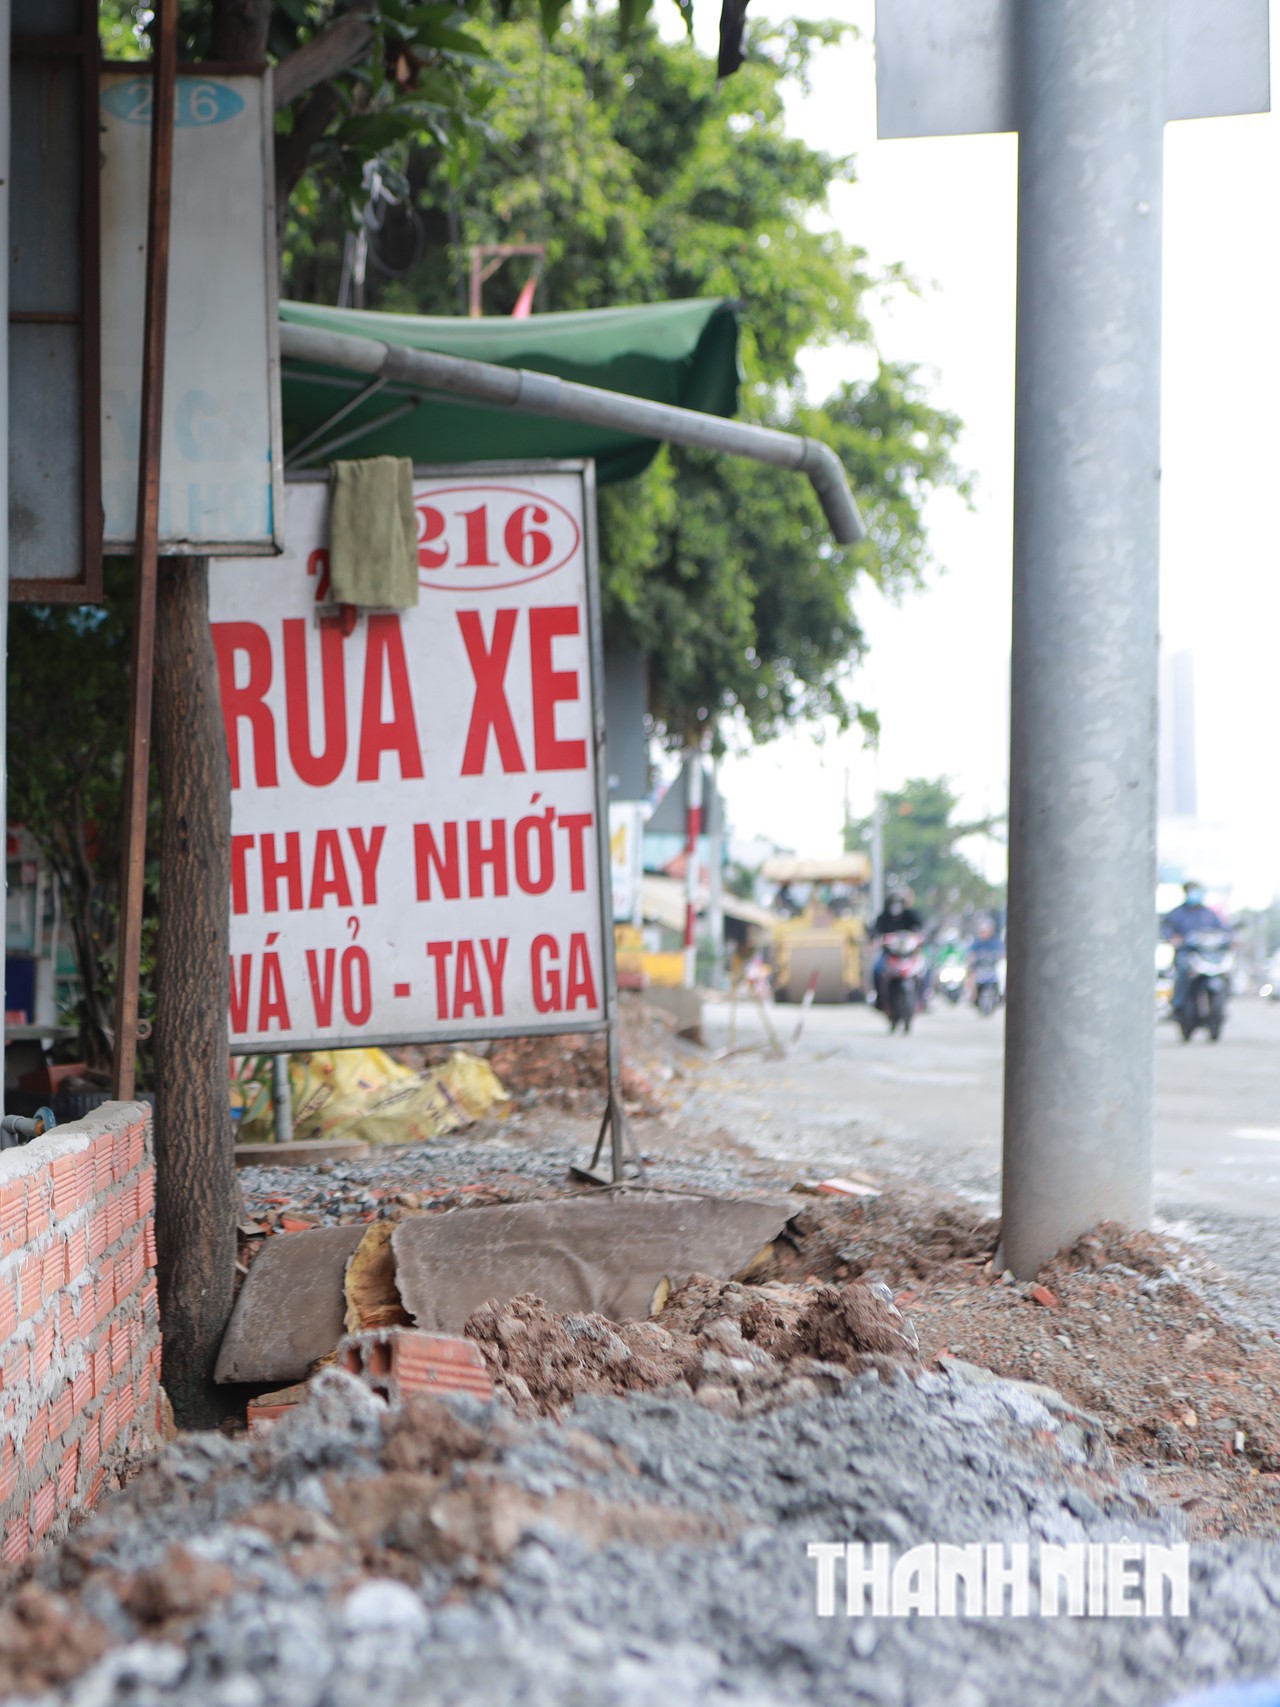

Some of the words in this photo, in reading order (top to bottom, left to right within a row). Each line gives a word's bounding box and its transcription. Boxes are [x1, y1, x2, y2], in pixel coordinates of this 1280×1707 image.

[416, 503, 553, 570] 216
[455, 605, 587, 778] XE
[230, 825, 387, 915] THAY
[413, 792, 593, 903] NHỚT
[229, 931, 292, 1034] VÁ
[305, 915, 372, 1028] VỎ
[426, 937, 509, 1020] TAY
[530, 932, 598, 1014] GA
